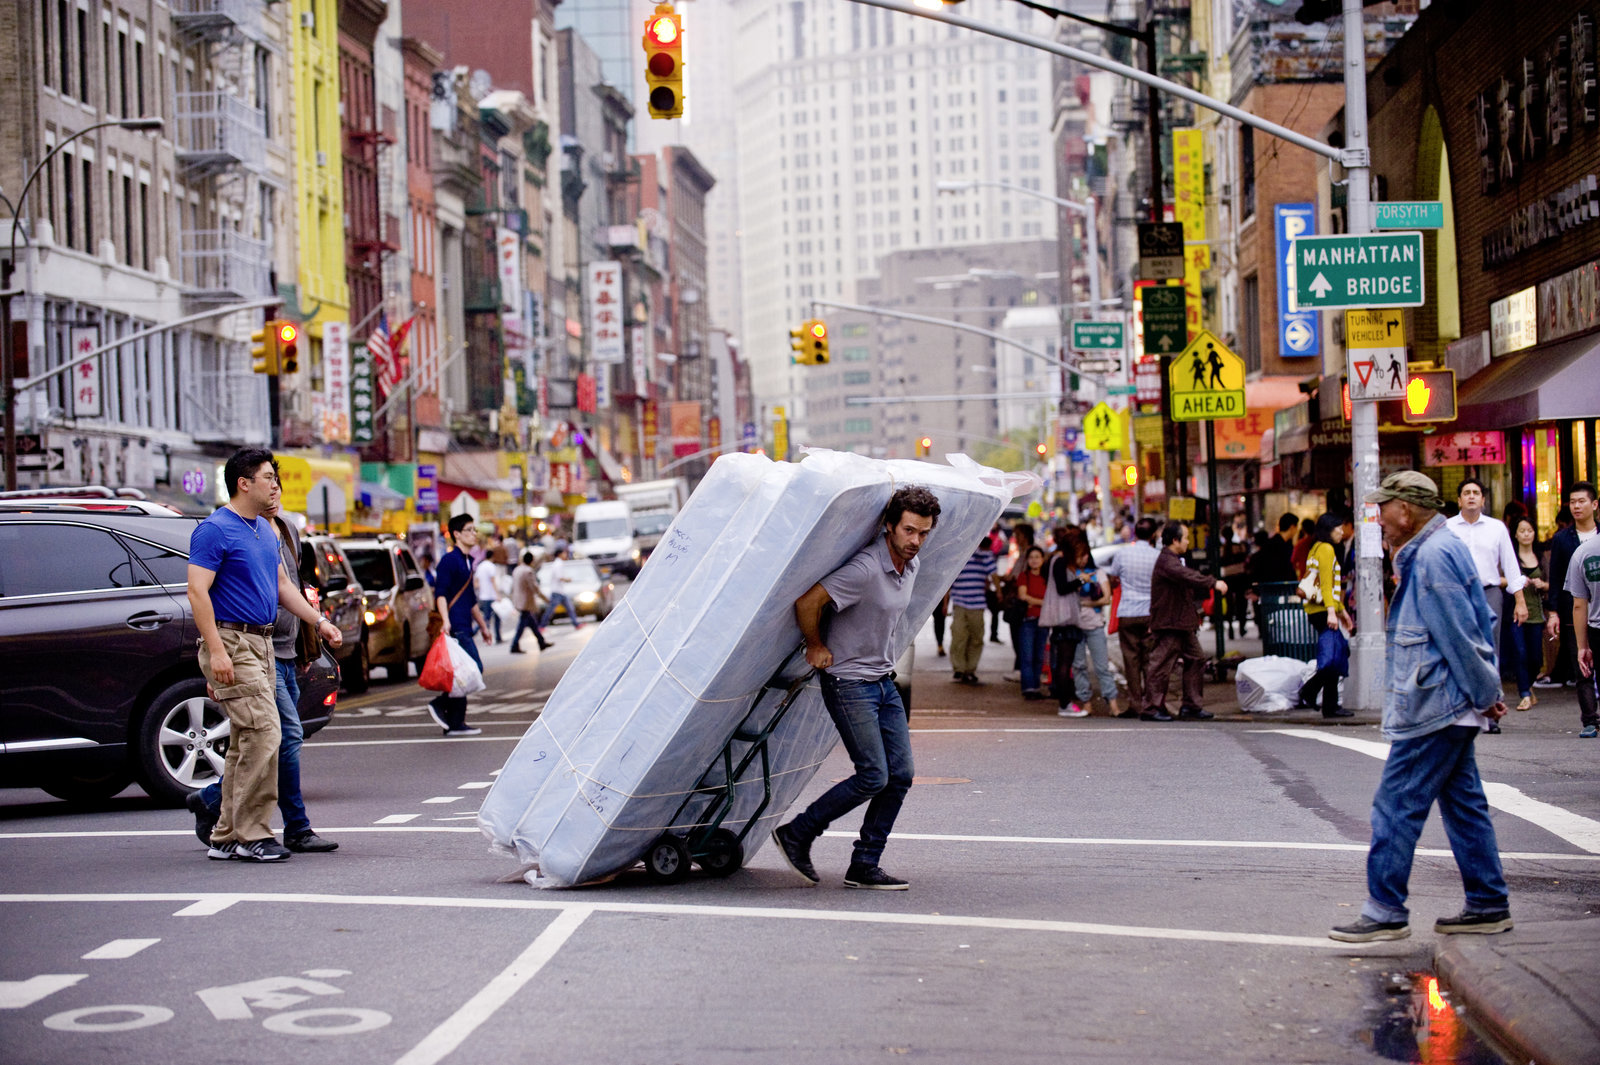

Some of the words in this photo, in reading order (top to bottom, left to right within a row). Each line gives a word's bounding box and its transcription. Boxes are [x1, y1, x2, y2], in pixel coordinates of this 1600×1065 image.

[1376, 205, 1428, 218] FORSYTH
[1304, 245, 1414, 266] MANHATTAN
[1347, 276, 1412, 296] BRIDGE
[1351, 314, 1384, 326] TURNING
[1352, 330, 1384, 340] VEHICLES
[1183, 396, 1235, 413] AHEAD
